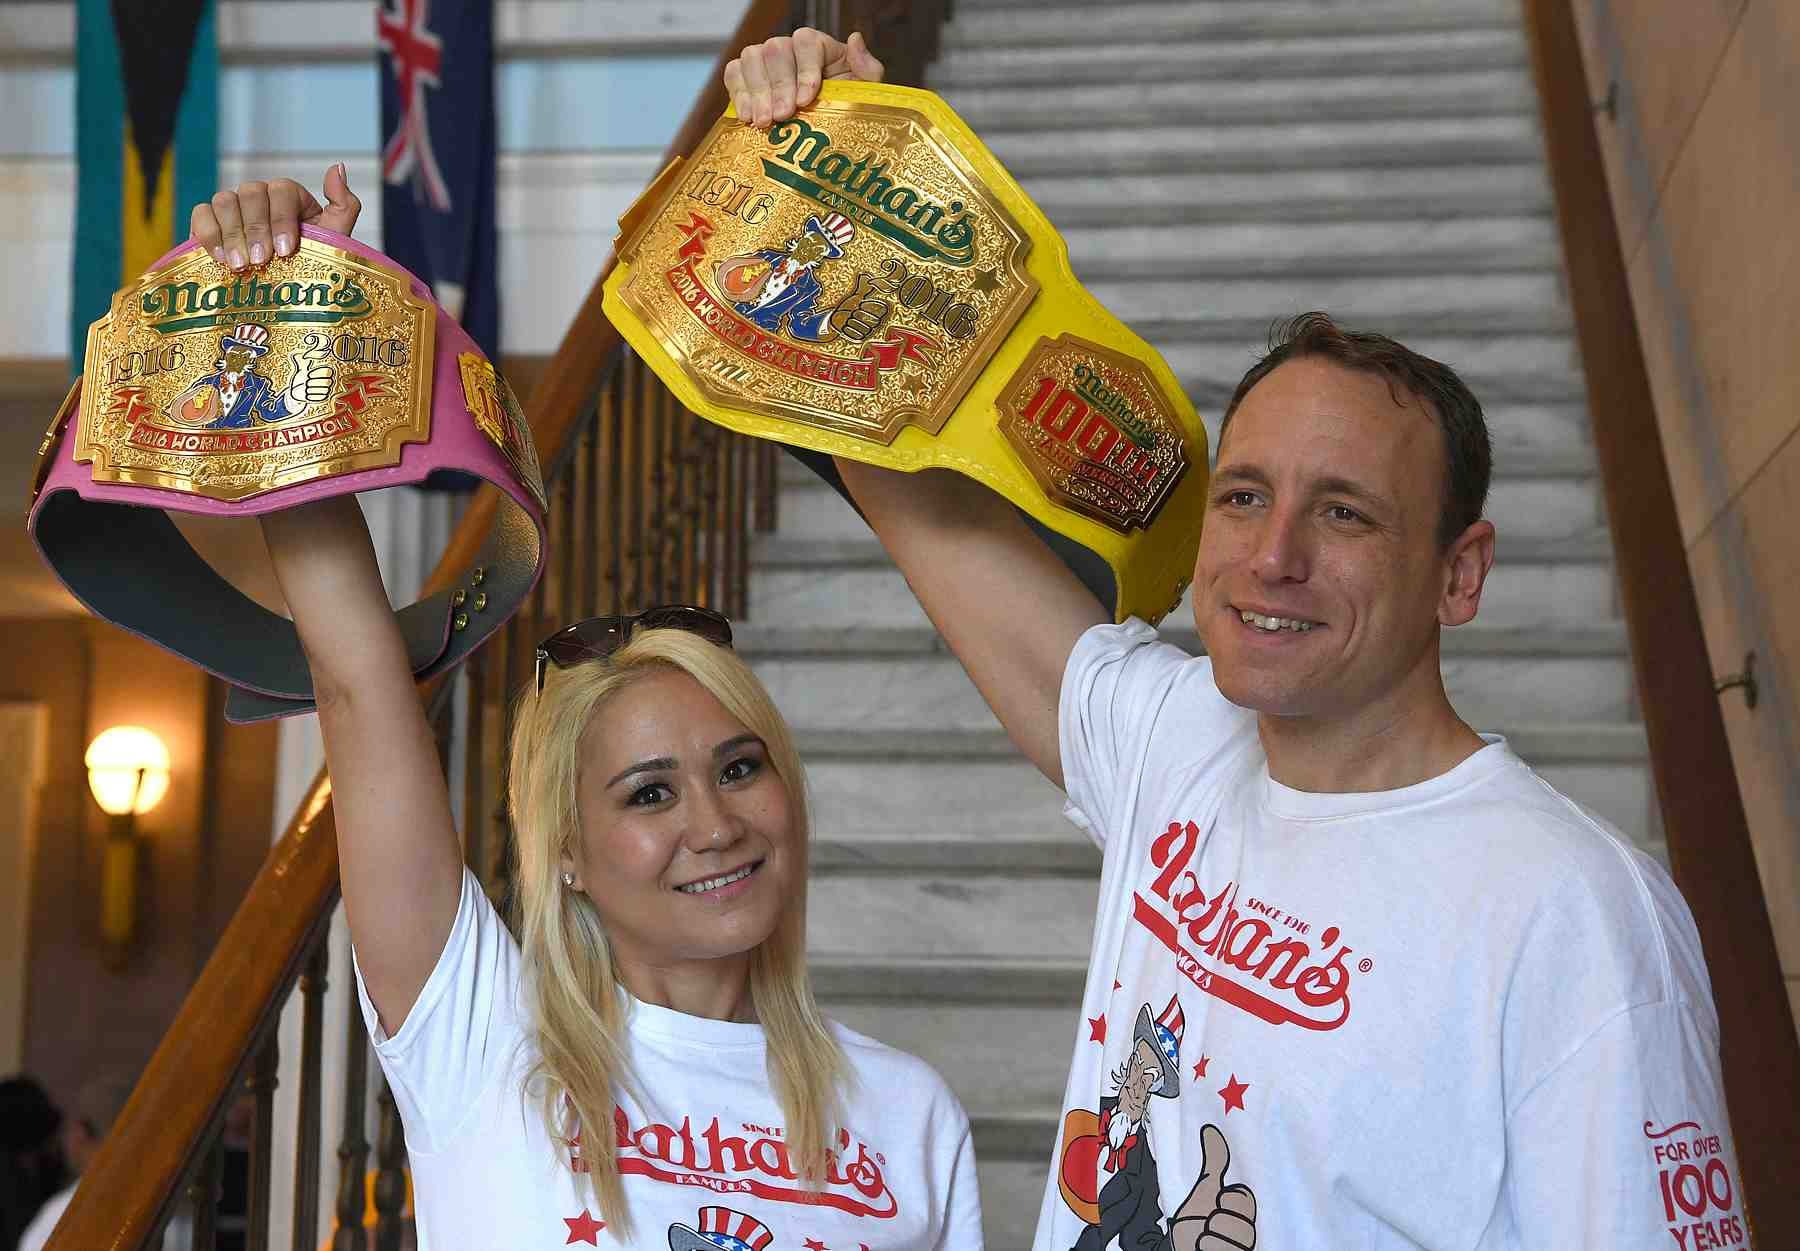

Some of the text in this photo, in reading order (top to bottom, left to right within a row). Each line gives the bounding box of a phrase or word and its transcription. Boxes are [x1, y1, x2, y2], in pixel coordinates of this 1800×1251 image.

[688, 170, 775, 224] 1916
[768, 119, 975, 252] Nathan's
[142, 272, 370, 316] Nathan's
[869, 258, 979, 338] 2016
[671, 266, 700, 301] 2016
[694, 299, 756, 349] WORLD
[758, 341, 871, 385] CHAMPION
[105, 342, 186, 387] 1916
[303, 333, 408, 367] 2016
[136, 415, 353, 451] 2016 WORLD CHAMPION
[1023, 377, 1159, 488] 100TH
[1246, 897, 1312, 935] SINCE 1916
[1176, 949, 1213, 989] MOUS
[742, 1122, 784, 1137] SINCE
[1653, 1135, 1722, 1164] FOR OVER
[675, 1174, 752, 1192] FAMOUS
[1660, 1158, 1732, 1222] 100
[1669, 1215, 1744, 1251] YEARS
